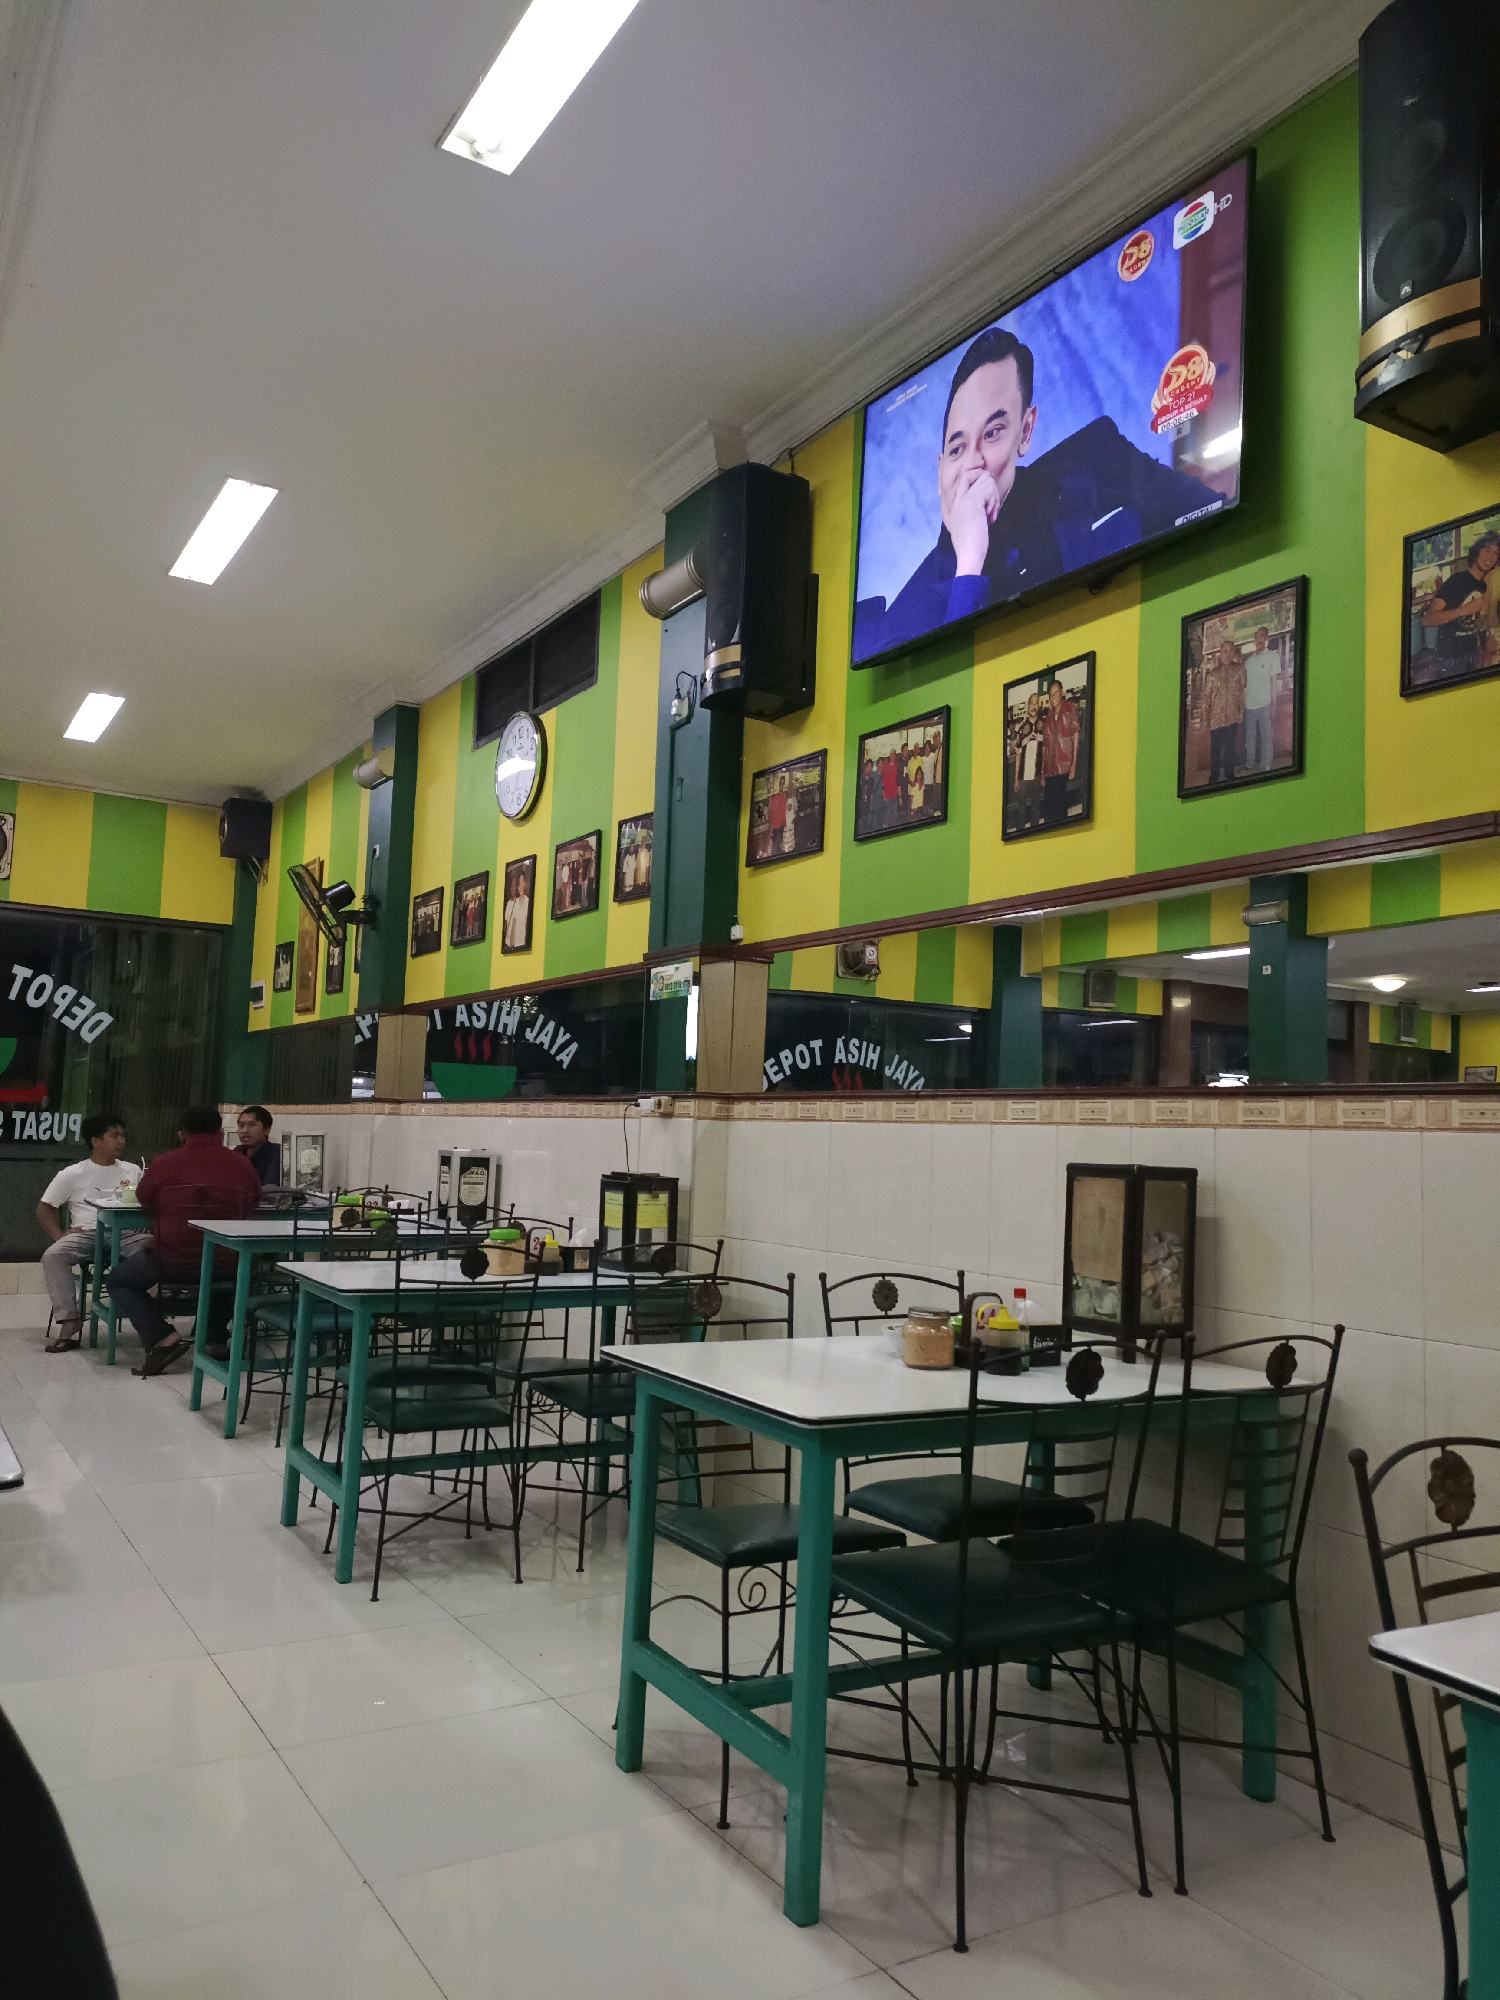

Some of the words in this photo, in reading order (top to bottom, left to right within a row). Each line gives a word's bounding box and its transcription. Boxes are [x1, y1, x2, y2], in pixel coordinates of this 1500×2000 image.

[1213, 194, 1232, 215] HD
[1157, 409, 1179, 425] GROUP
[1184, 394, 1208, 410] RESULT
[1169, 396, 1186, 411] TOP
[1187, 390, 1196, 403] 21
[455, 1000, 522, 1036] ASIH
[525, 1013, 579, 1070] JAYA
[834, 1037, 882, 1071] ASIH
[884, 1053, 926, 1091] JAYA
